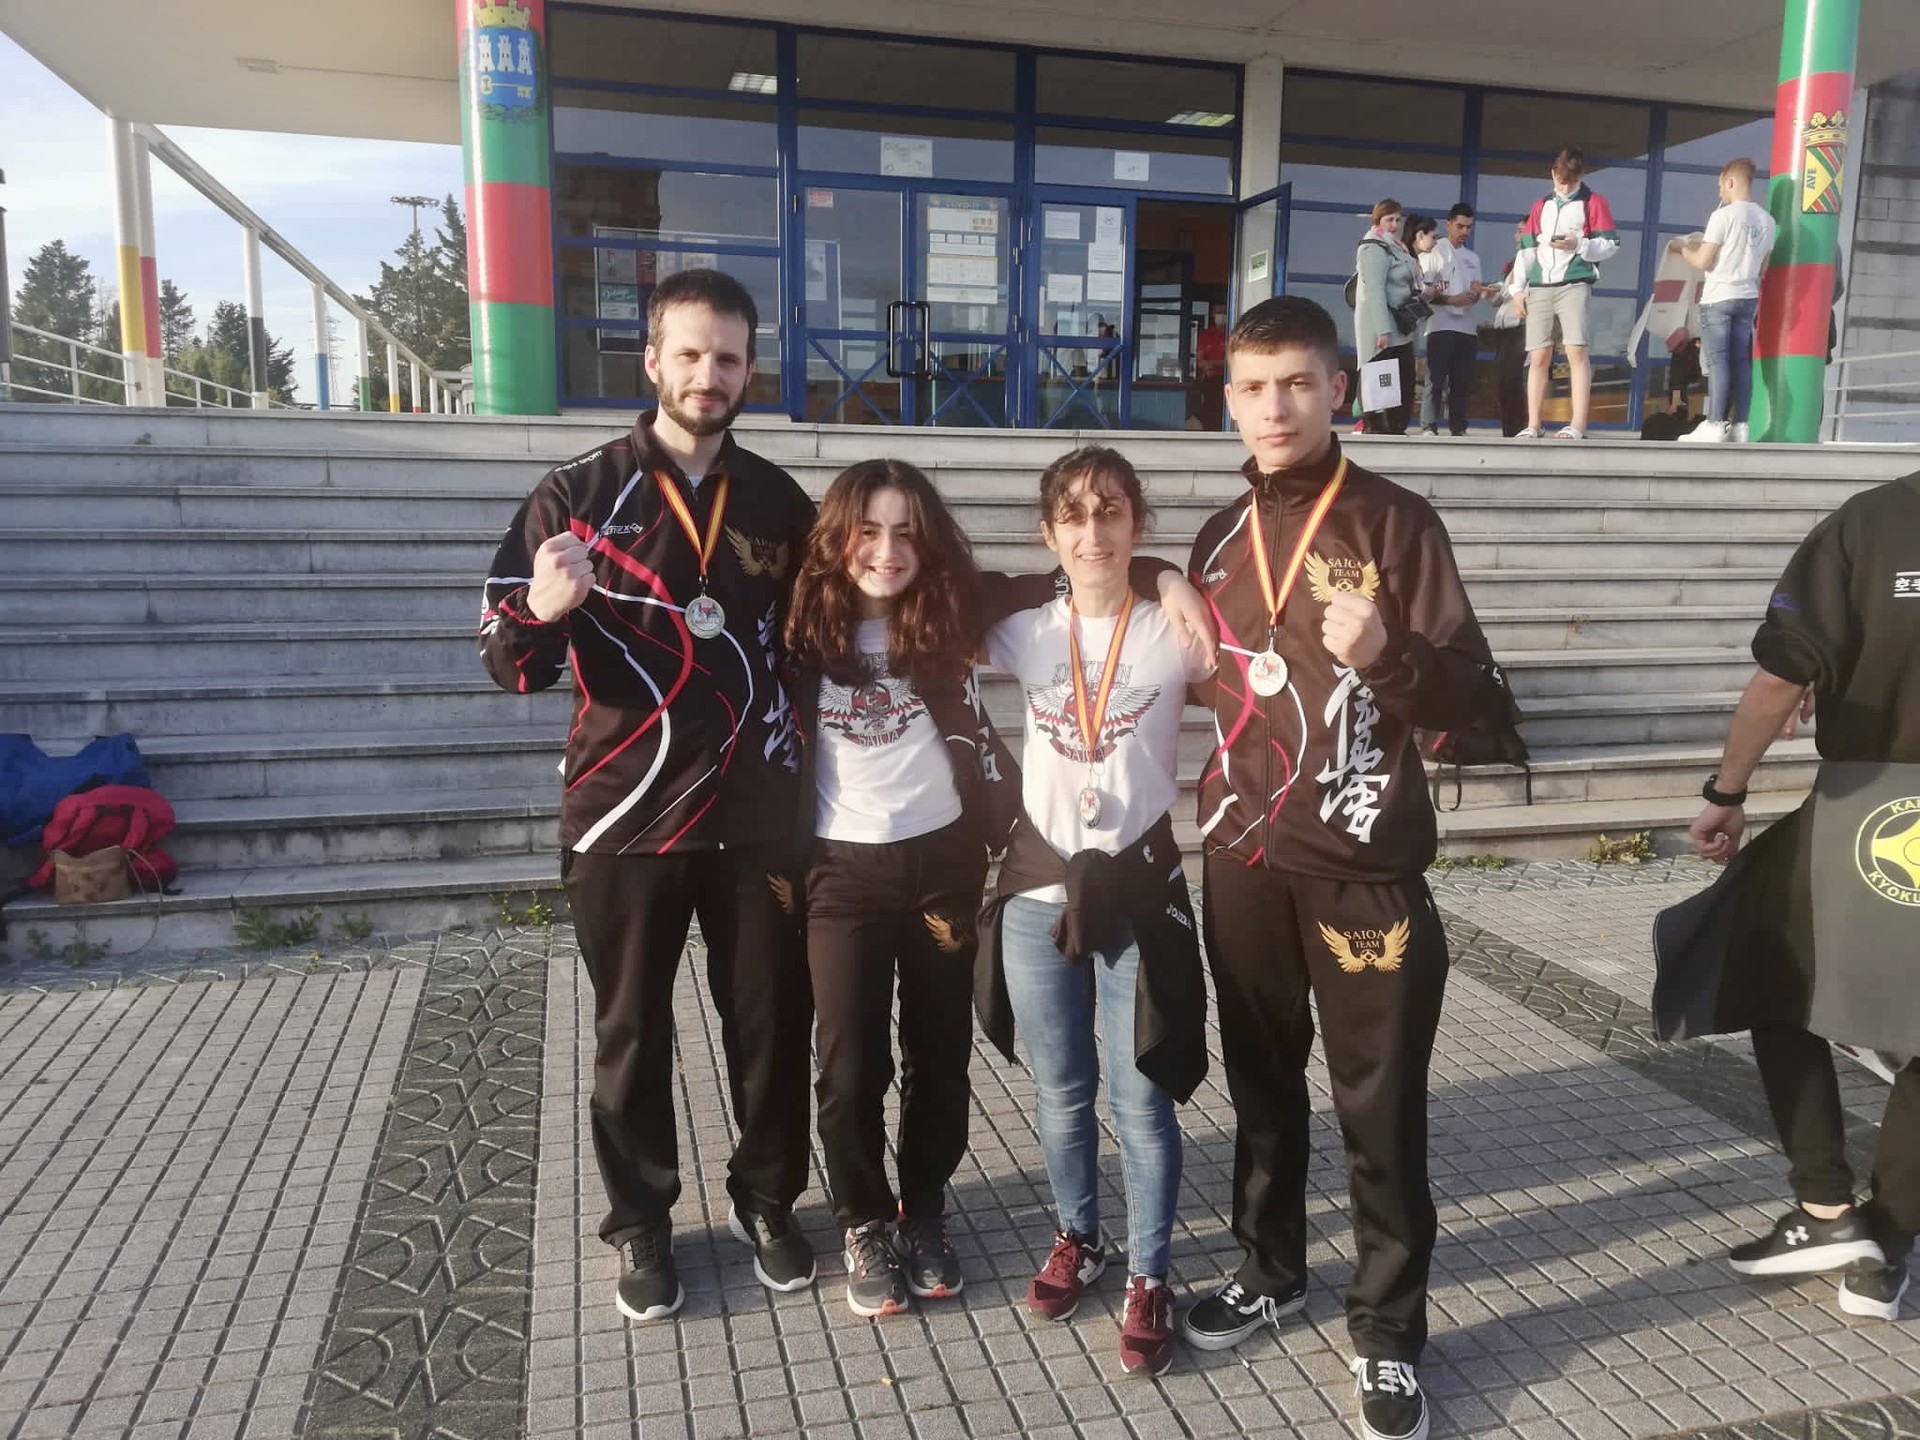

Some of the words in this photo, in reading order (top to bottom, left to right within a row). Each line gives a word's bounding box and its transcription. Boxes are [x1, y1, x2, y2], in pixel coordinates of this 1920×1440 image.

[1806, 168, 1817, 190] AVE
[1334, 569, 1359, 578] TEAM
[1343, 929, 1386, 940] SAIOA
[1354, 940, 1380, 949] TEAM
